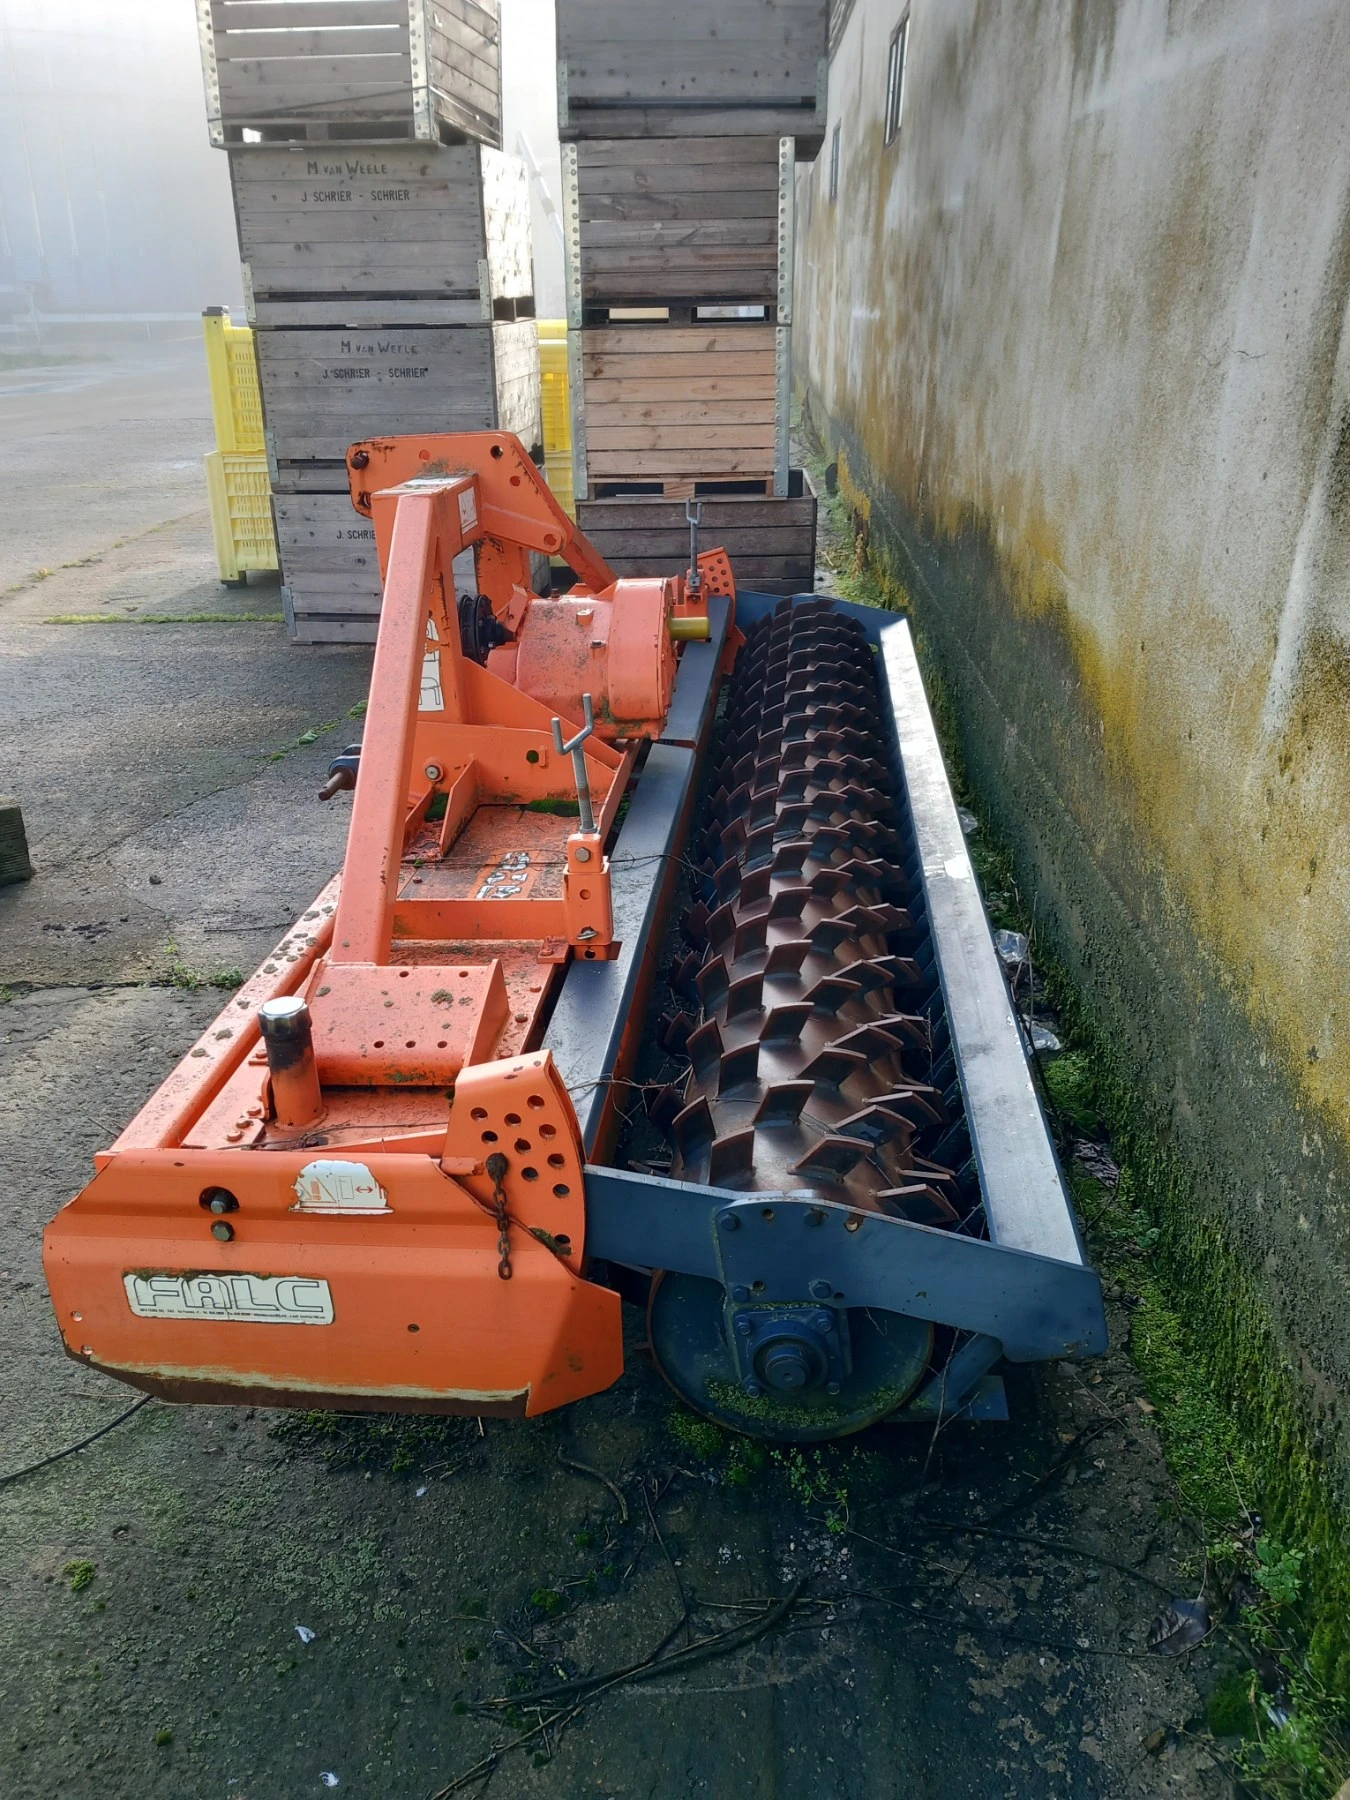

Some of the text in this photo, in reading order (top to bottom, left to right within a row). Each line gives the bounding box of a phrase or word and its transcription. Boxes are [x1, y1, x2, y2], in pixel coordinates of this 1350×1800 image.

[345, 160, 389, 175] WEELE
[313, 190, 352, 202] SCHRIER
[371, 189, 410, 201] SCHRIER
[378, 341, 418, 354] WEELE
[333, 368, 371, 379] SCHRIER
[389, 367, 426, 378] SCHRIER
[347, 529, 376, 540] SCHRIE
[133, 1275, 324, 1313] FALC
